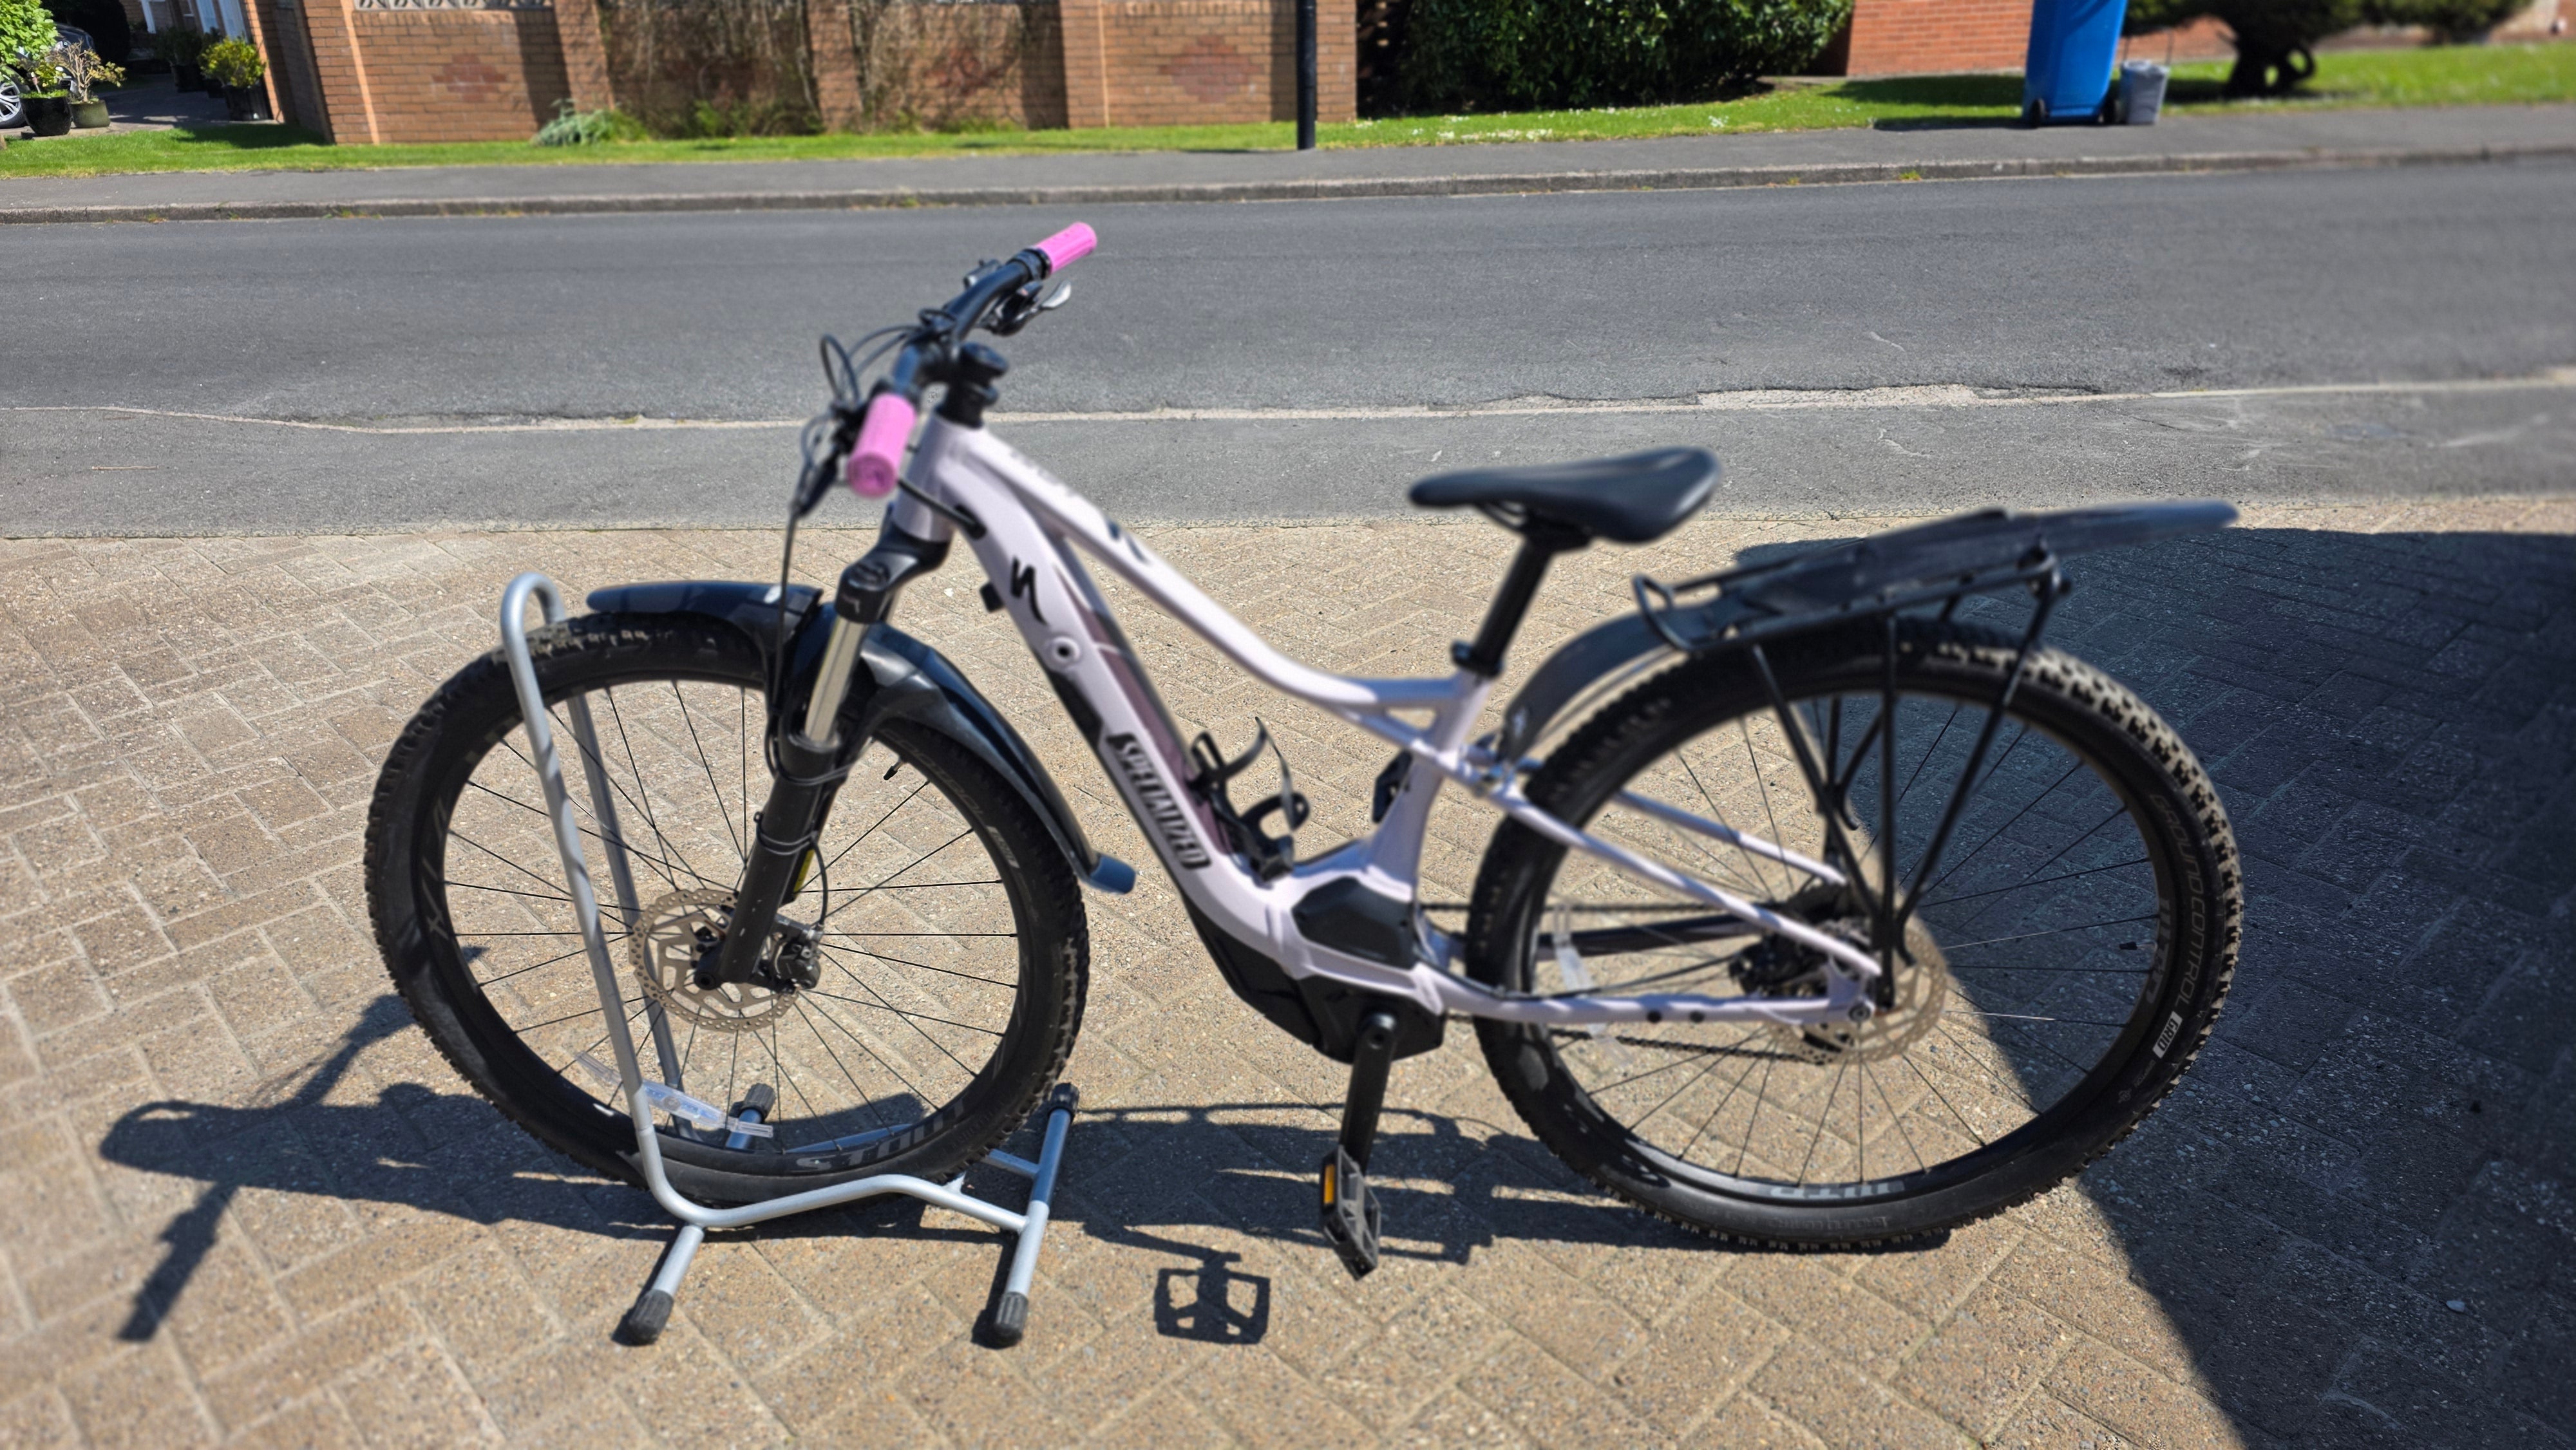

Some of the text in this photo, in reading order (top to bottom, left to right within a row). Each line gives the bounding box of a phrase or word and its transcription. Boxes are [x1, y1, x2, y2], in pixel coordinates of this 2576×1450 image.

[2150, 793, 2206, 1007] GROUND CONTROL
[2156, 1015, 2181, 1055] GRID
